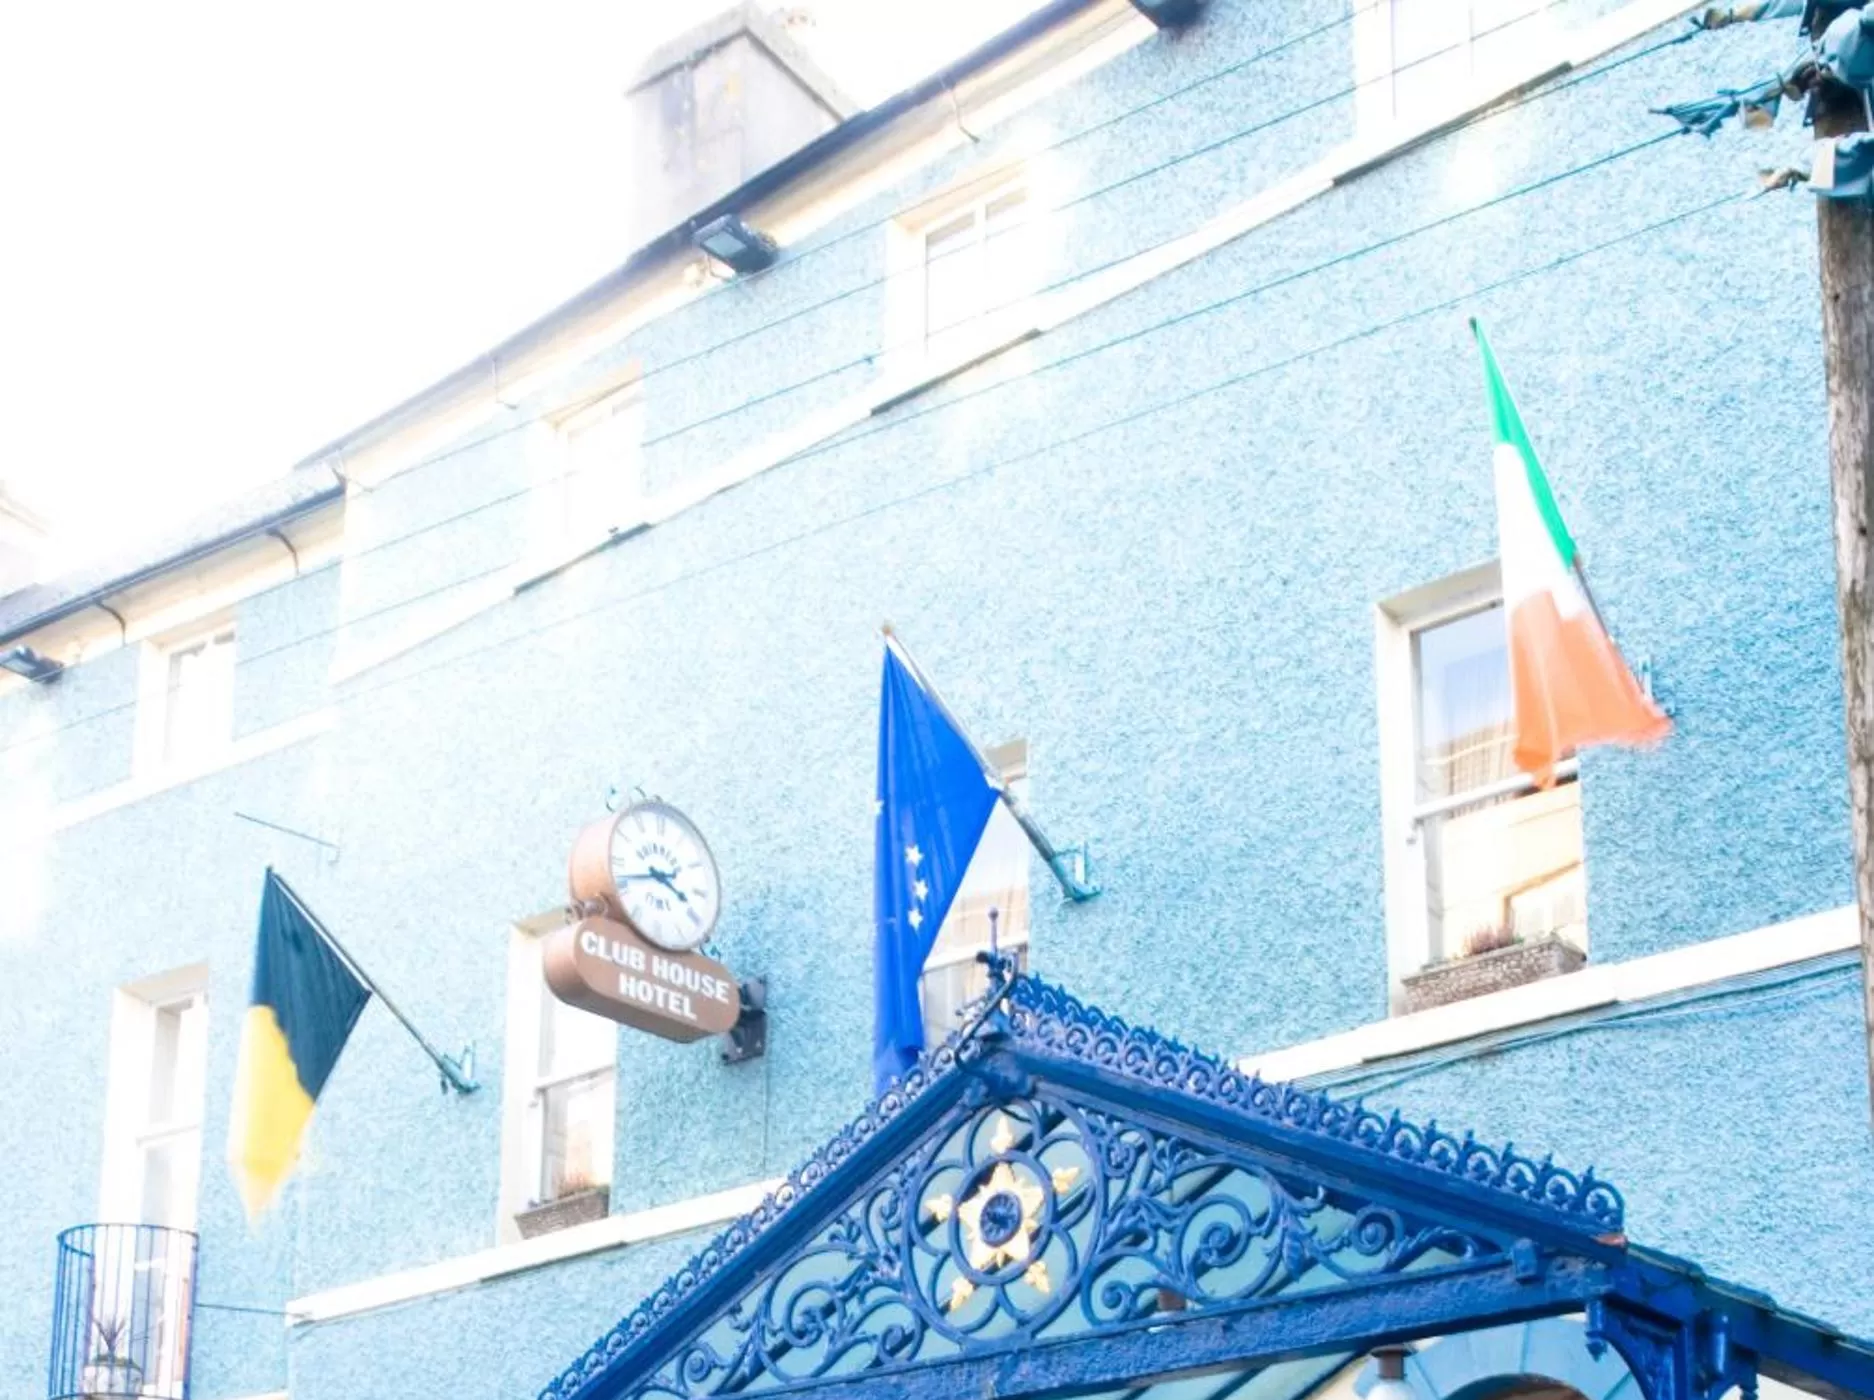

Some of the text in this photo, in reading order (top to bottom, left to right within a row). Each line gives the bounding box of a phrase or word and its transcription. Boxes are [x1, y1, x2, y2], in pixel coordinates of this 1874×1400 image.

[580, 930, 730, 1004] CLUB HOUSE
[618, 972, 698, 1021] HOTEL
